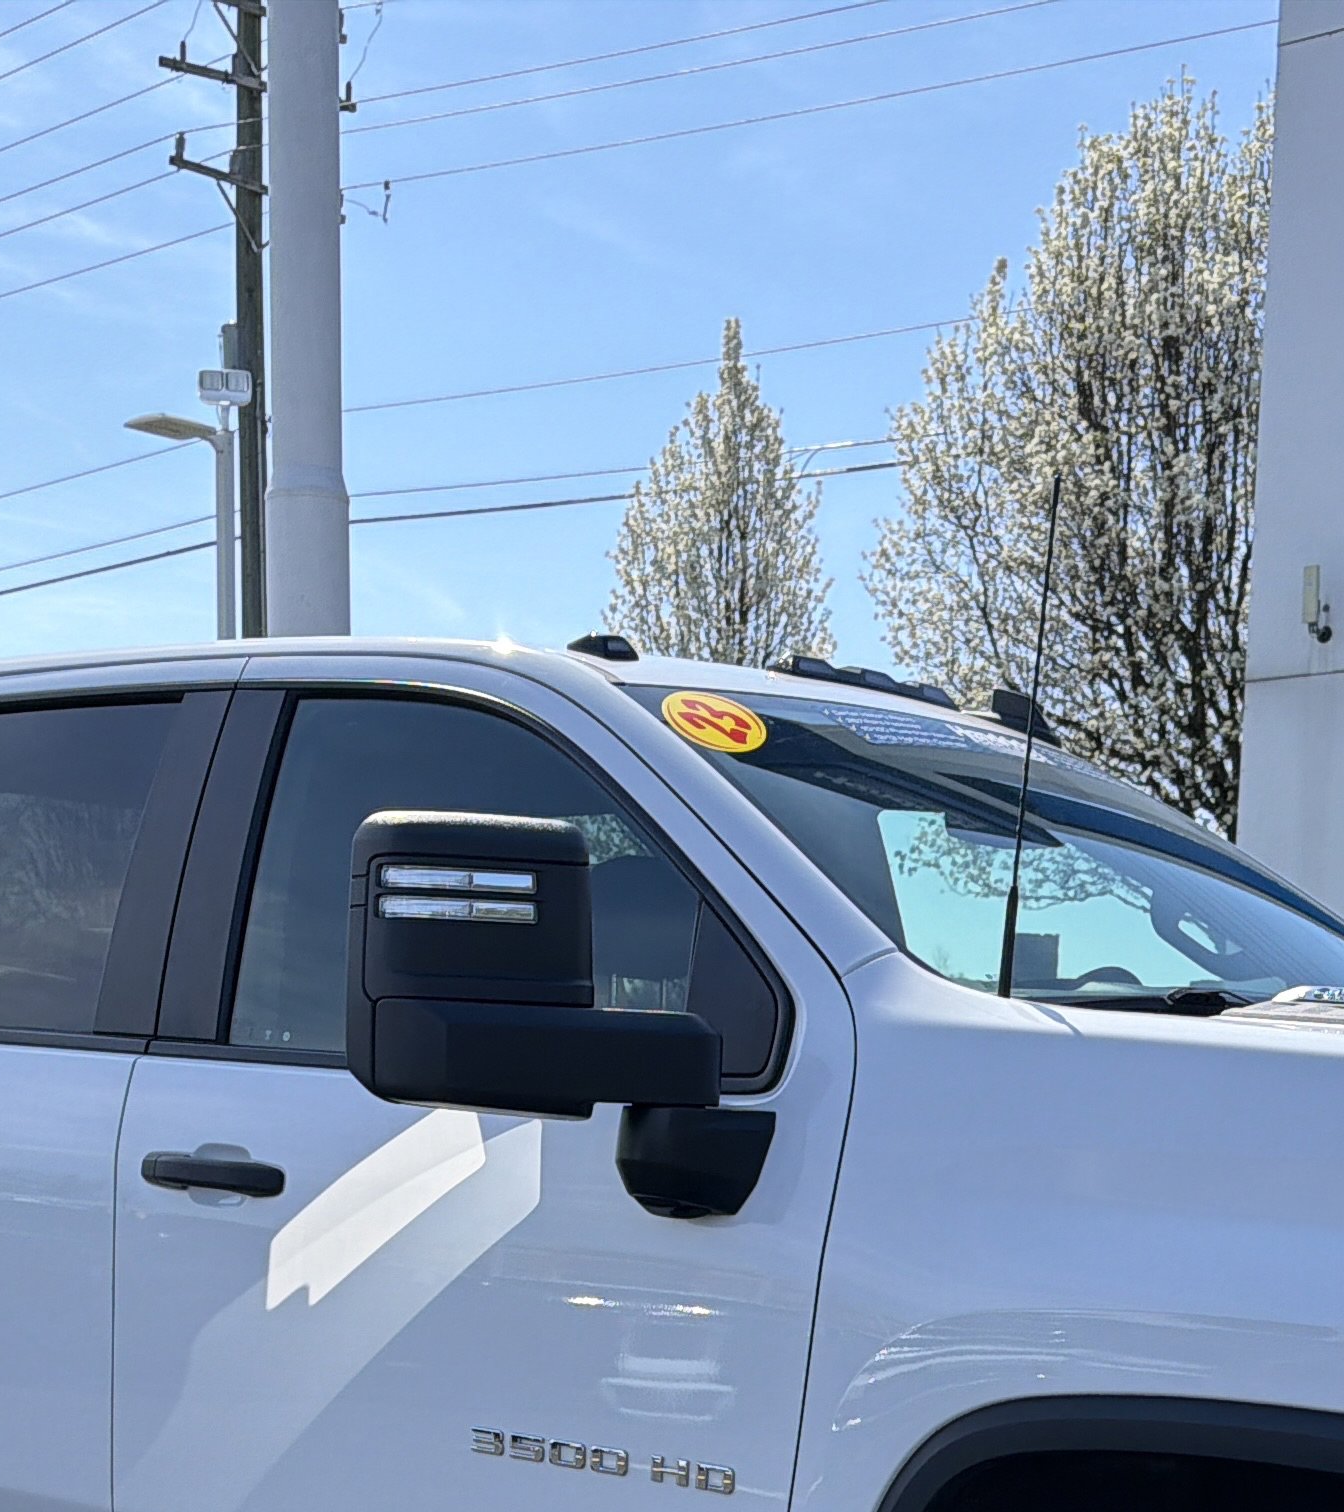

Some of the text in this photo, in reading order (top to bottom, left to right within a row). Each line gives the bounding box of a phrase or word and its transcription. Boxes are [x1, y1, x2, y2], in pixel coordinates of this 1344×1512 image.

[677, 698, 752, 744] 23
[470, 1426, 736, 1496] 3500 HD
